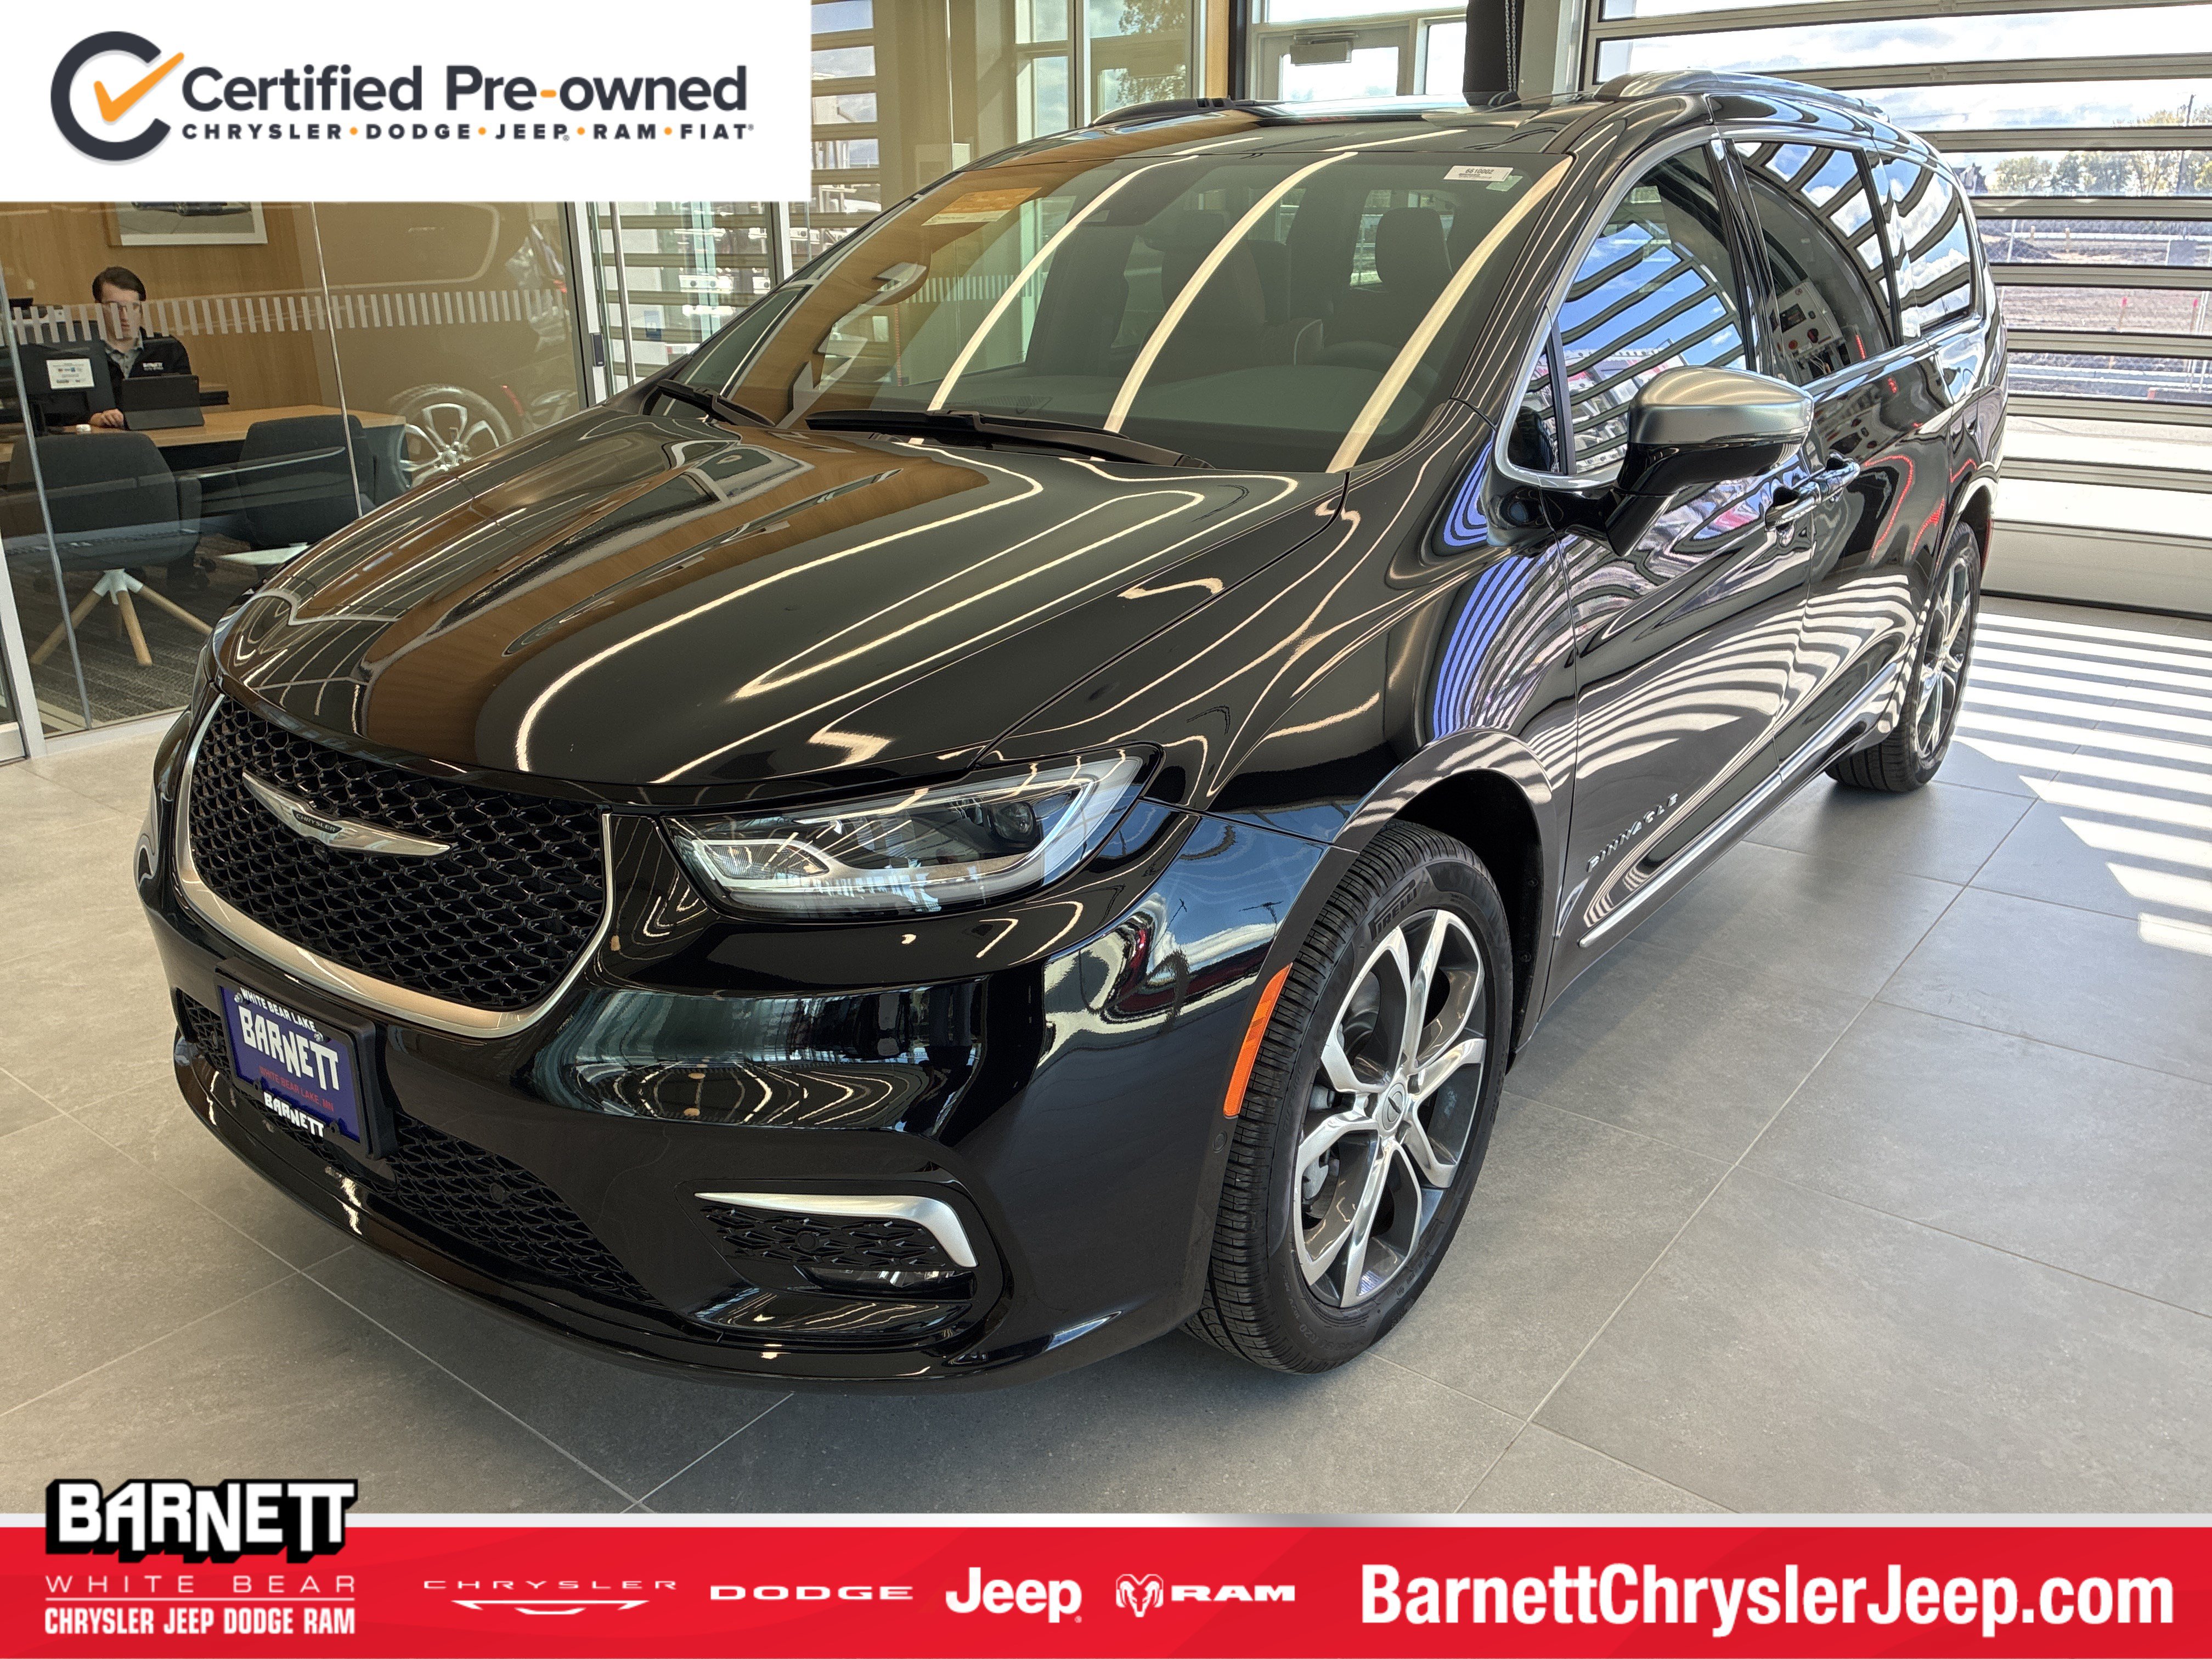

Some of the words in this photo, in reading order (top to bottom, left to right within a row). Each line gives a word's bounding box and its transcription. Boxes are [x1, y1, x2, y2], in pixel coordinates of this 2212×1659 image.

[296, 813, 336, 832] CHRYSLER
[1368, 879, 1417, 941] PIRELLI
[240, 987, 268, 1010] WHITE
[267, 1000, 292, 1022] BEAR
[291, 1012, 317, 1032] LAKE
[238, 1005, 340, 1091] BARNETT
[259, 1065, 280, 1084] WHITE
[280, 1077, 300, 1094] BEAR
[263, 1091, 325, 1138] BARNETT
